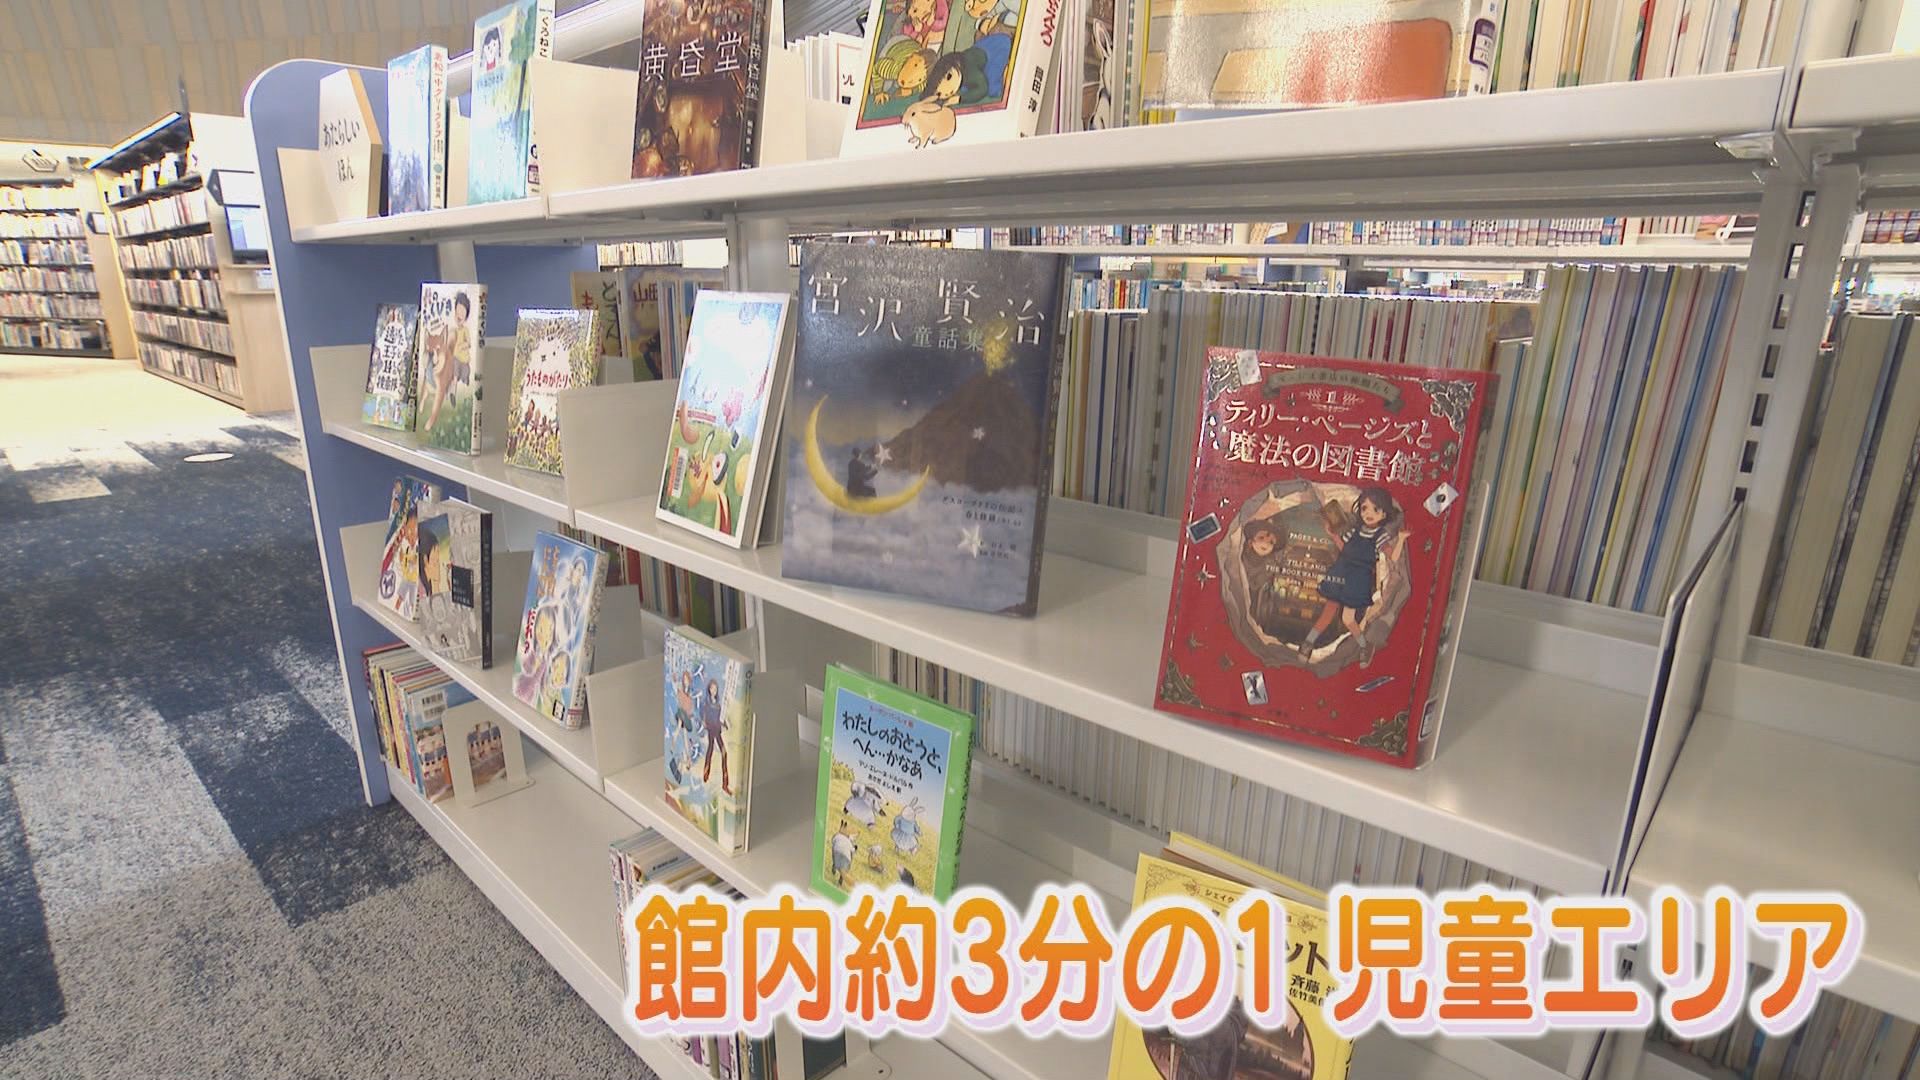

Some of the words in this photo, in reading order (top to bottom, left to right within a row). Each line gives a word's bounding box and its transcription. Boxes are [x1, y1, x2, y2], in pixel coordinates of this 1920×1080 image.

[643, 31, 742, 81] 黄昏堂
[322, 119, 360, 148] あたらしい
[337, 156, 355, 182] ほん
[808, 271, 1045, 346] 宮沢賢治
[911, 325, 984, 351] 童話集
[526, 367, 569, 389] うたものがたり
[1224, 400, 1433, 449] ティリー・ページズと
[1224, 431, 1425, 485] 魔法の図書館
[842, 710, 942, 775] わたしのおとうと、
